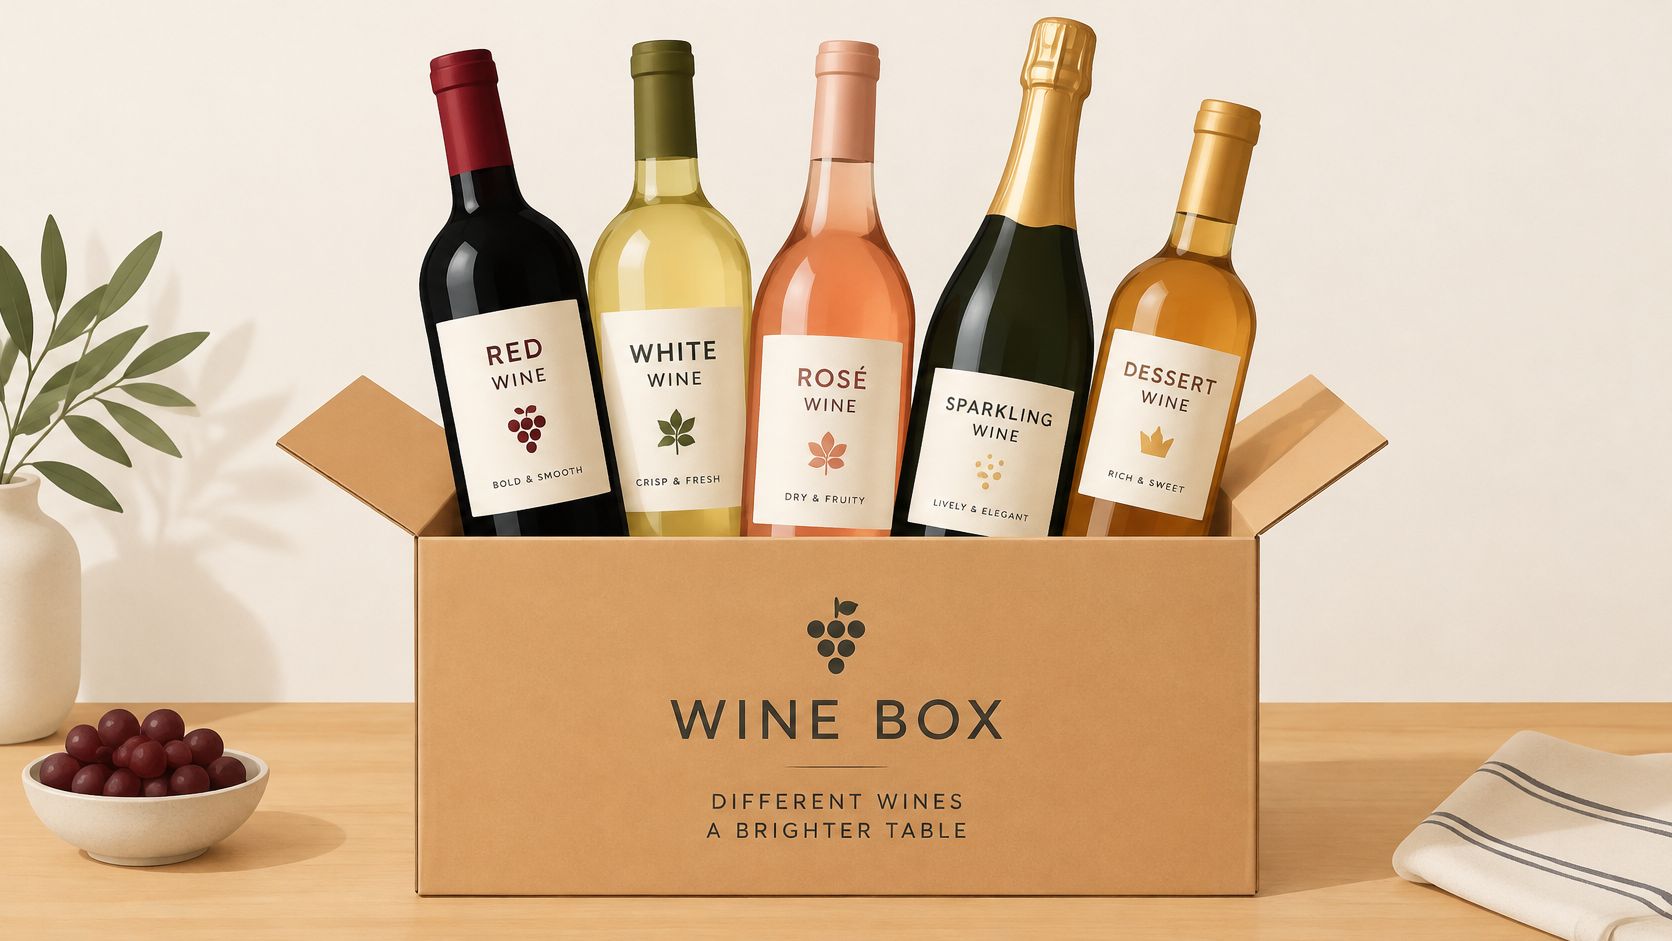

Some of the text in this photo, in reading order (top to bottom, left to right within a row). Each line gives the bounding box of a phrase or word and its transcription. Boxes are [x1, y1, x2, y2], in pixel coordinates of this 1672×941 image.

[486, 338, 543, 366] RED
[629, 340, 717, 364] WHITE
[491, 367, 547, 391] WINE
[647, 370, 702, 388] WINE
[798, 365, 867, 390] ROSÉ
[1123, 361, 1218, 396] DESSERT
[804, 397, 857, 414] WINE
[945, 396, 1053, 427] SPARKLING
[1141, 390, 1190, 413] WINE
[972, 423, 1020, 443] WINE
[492, 466, 584, 489] BOLD & SMOOTH
[635, 474, 721, 487] CRISP & FRESH
[1107, 469, 1185, 494] RICH & SWEET
[784, 492, 866, 505] DRY & FRUITY
[933, 498, 1029, 522] LIVELY & ELEGANT
[670, 698, 1003, 741] WINE BOX
[712, 793, 962, 810] DIFFERENT WINES
[706, 822, 966, 839] A BRIGHTER TABLE
